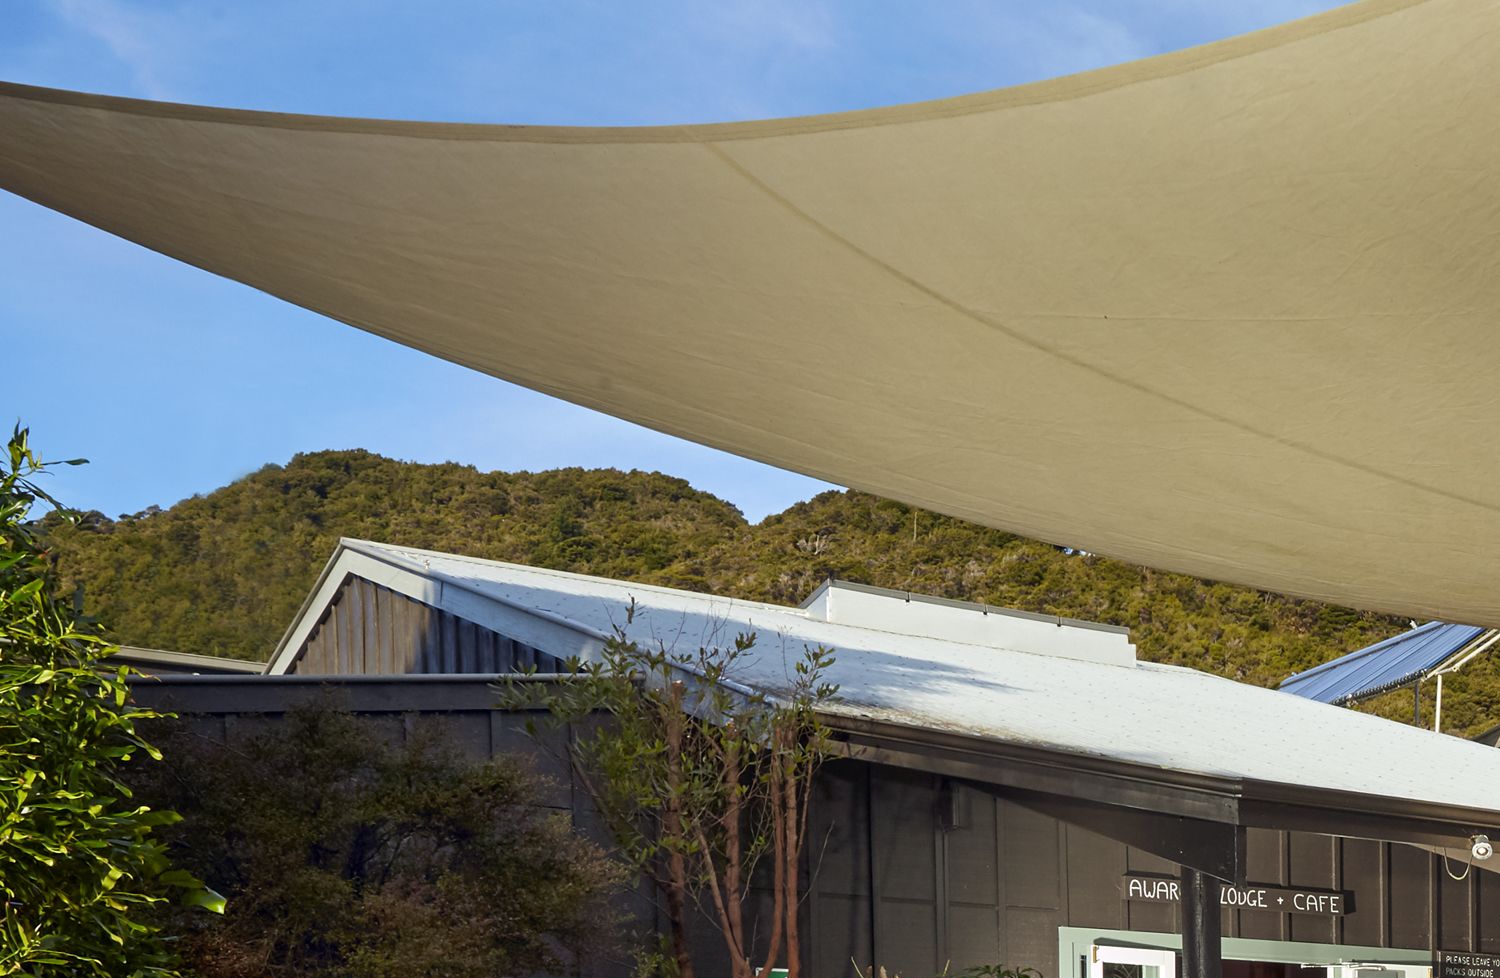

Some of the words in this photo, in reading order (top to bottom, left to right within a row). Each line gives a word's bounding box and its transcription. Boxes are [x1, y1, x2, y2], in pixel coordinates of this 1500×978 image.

[1129, 879, 1182, 900] AWAR
[1219, 886, 1268, 908] LODGE
[1293, 893, 1340, 913] CAFE
[1445, 955, 1471, 966] PLEASE
[1471, 957, 1491, 967] LEAVE
[1445, 967, 1466, 977] PACKS
[1467, 968, 1494, 978] OUTSIDE
